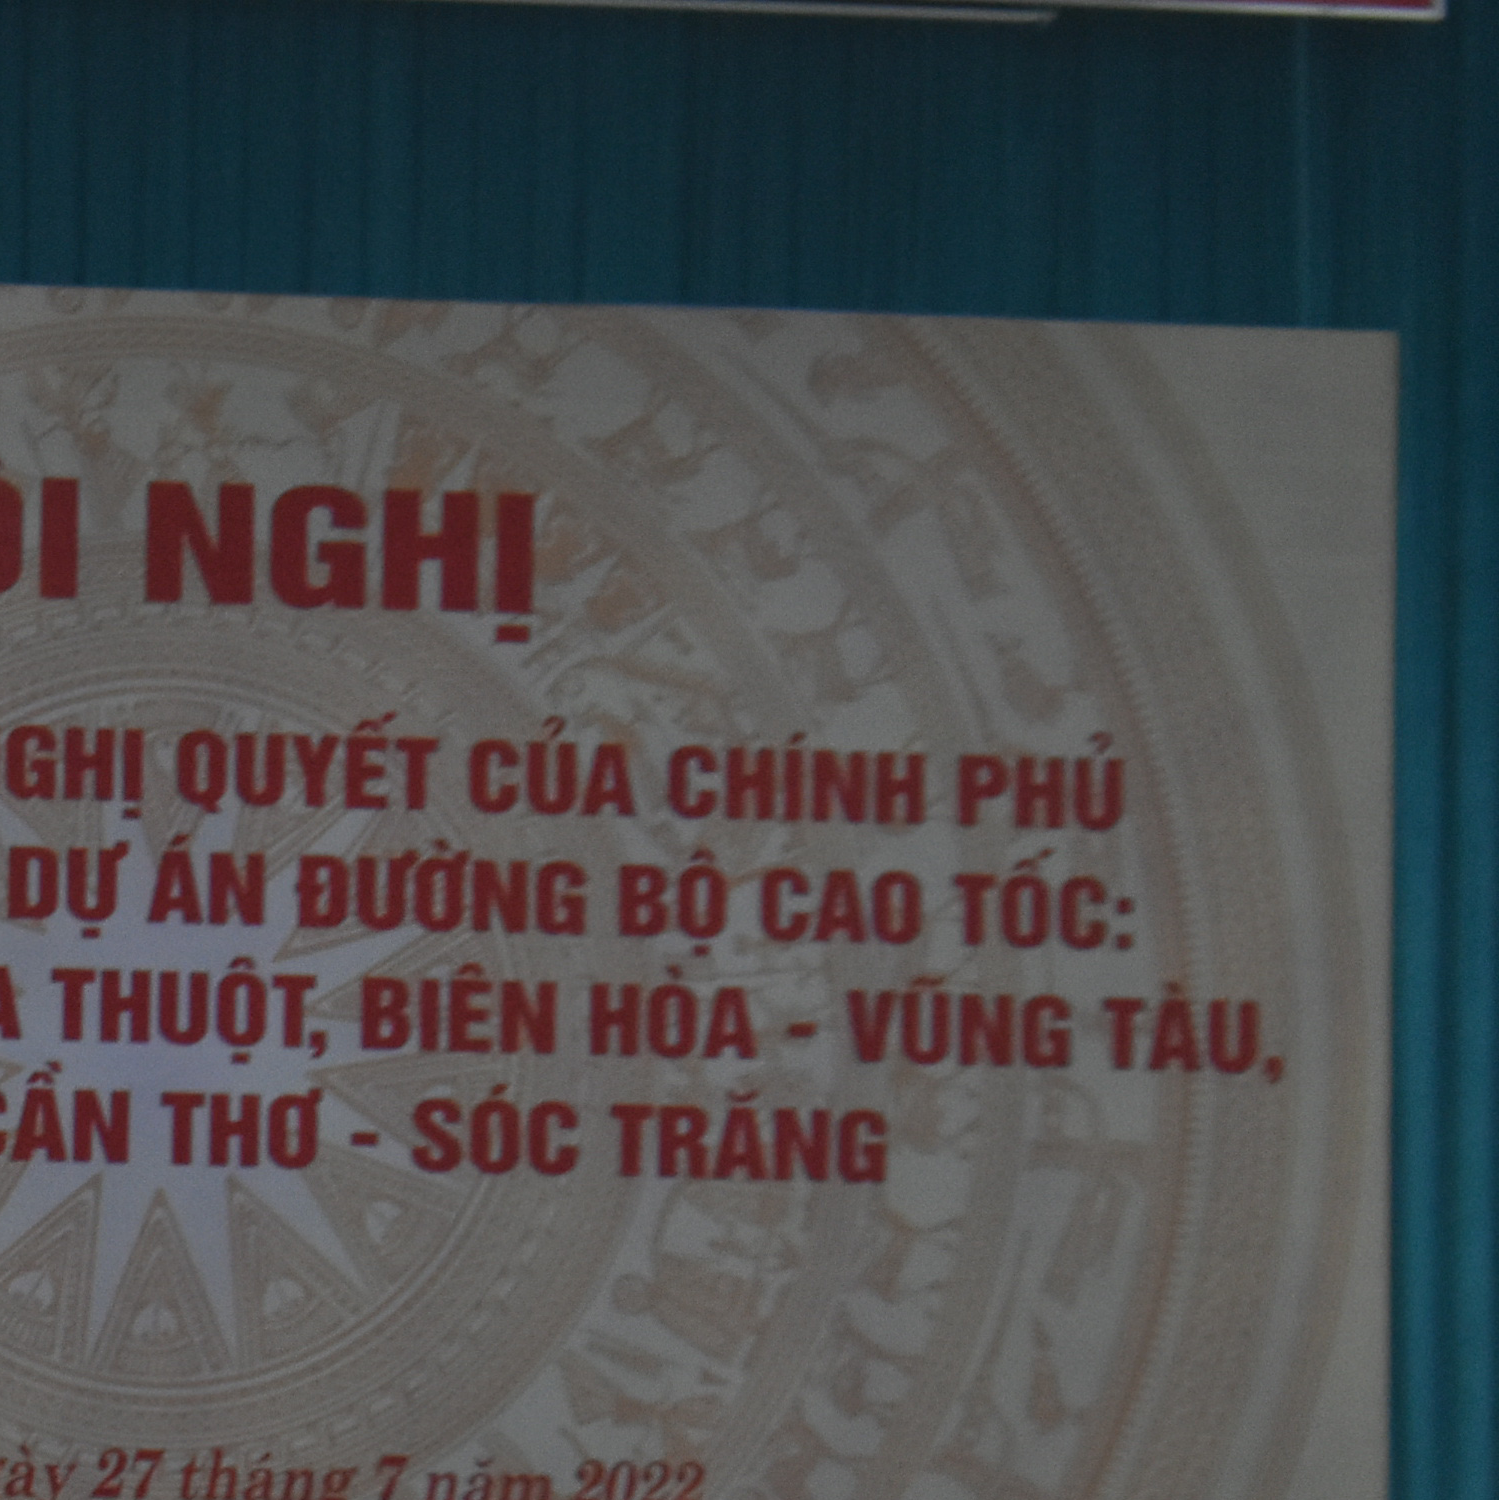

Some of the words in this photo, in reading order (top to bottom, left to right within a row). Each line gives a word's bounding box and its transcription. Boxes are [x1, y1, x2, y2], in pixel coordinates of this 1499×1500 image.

[145, 479, 536, 643] NGHỊ
[176, 711, 439, 813] QUYẾT
[468, 716, 634, 816] CỦA
[667, 732, 925, 824] CHÍNH
[956, 730, 1125, 832] PHỦ
[7, 841, 130, 939] DỰ
[149, 833, 266, 927] ÁN
[296, 850, 586, 935] ĐƯỜNG
[617, 849, 730, 957] BỘ
[760, 866, 922, 945] CAO
[954, 848, 1136, 950] TỐC:
[52, 956, 326, 1064] THUỘT,
[360, 962, 558, 1055] BIÊN
[589, 964, 758, 1059] HÒA
[787, 1021, 818, 1039] -
[847, 976, 1070, 1068] VŨNG
[1104, 983, 1286, 1086] TÀU,
[161, 1088, 322, 1169] THƠ
[350, 1131, 380, 1147] -
[412, 1083, 579, 1176] SÓC
[611, 1090, 887, 1183] TRĂNG
[92, 1447, 165, 1500] 27
